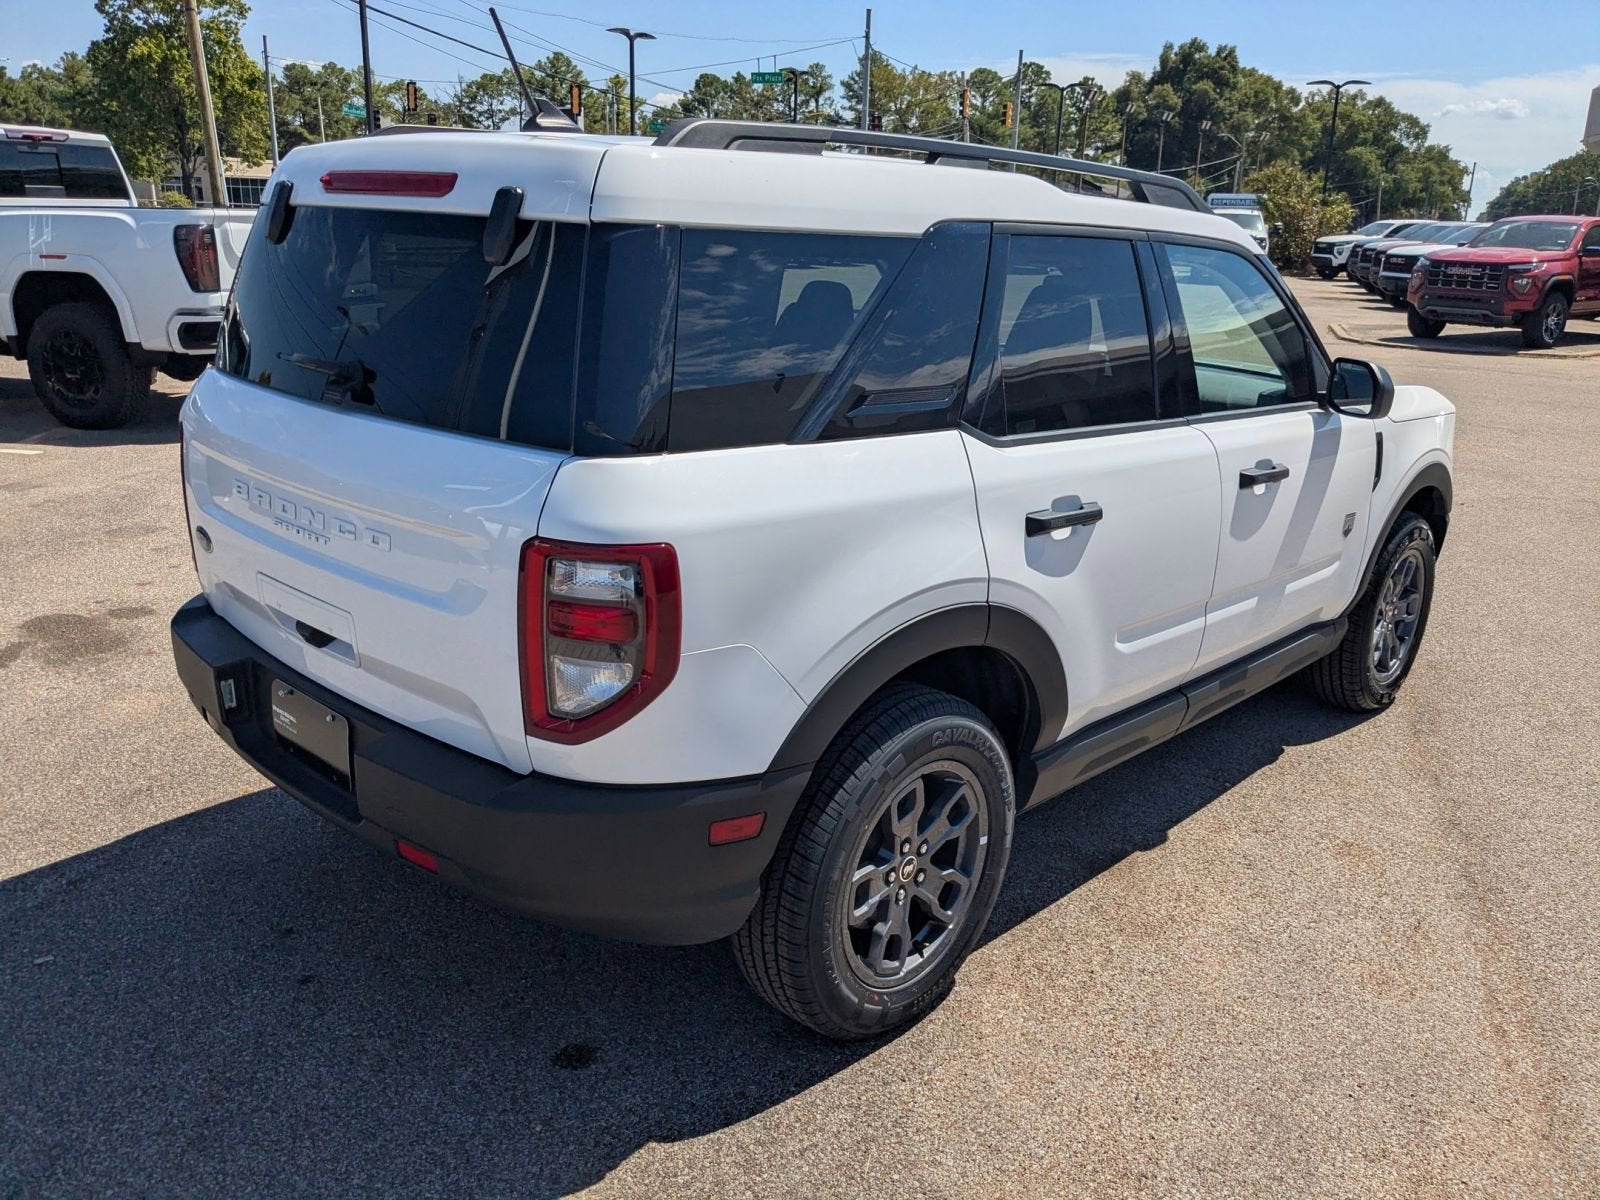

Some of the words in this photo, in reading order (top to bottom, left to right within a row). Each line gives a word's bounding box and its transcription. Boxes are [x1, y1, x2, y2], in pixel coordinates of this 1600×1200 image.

[1447, 266, 1482, 276] GMC
[232, 478, 392, 552] BRONCO
[271, 516, 331, 546] SPORT
